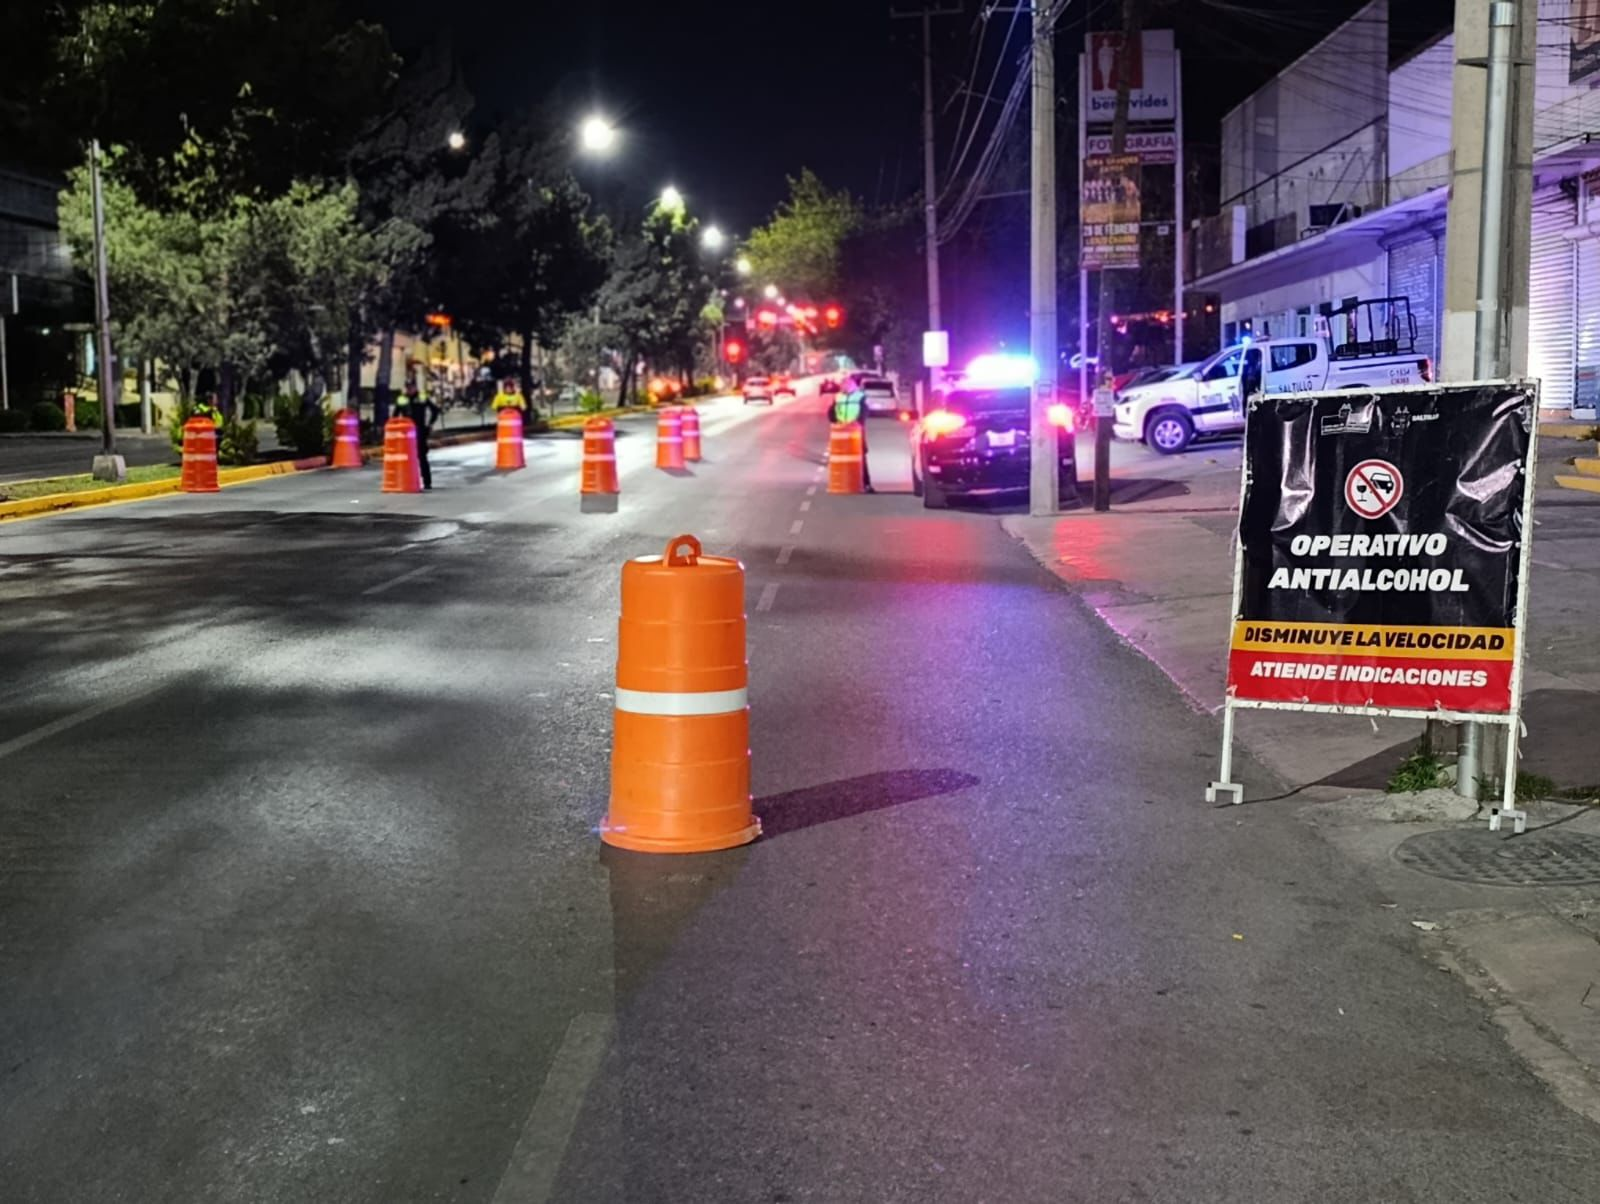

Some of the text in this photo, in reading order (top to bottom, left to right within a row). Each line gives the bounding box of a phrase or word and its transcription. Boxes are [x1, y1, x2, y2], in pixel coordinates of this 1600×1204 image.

[1291, 533, 1448, 557] OPERATIVO
[1268, 567, 1470, 592] ANTIALCOHOL
[1244, 627, 1505, 650] DISMINUYE LA VELOCIDAD
[1251, 661, 1488, 687] ATIENDE INDICACIONES
